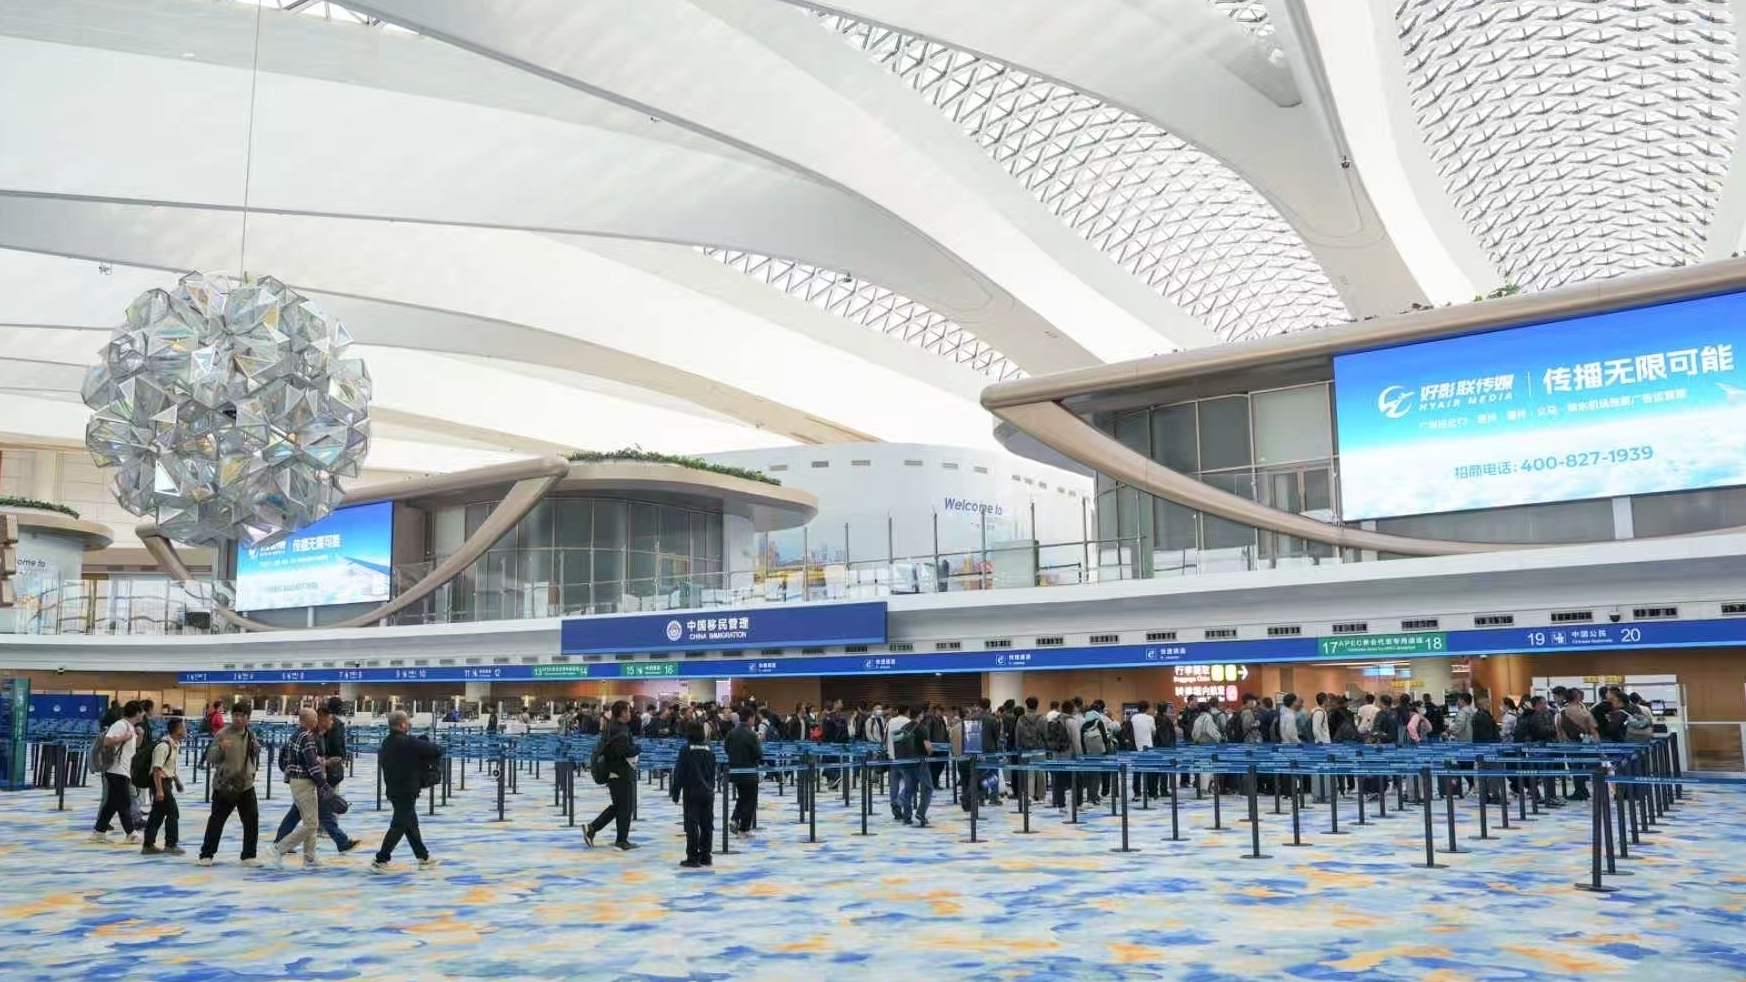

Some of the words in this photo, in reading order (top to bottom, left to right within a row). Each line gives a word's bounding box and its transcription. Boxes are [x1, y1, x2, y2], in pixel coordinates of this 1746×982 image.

[1543, 344, 1734, 395] 传播无限可能
[1420, 374, 1514, 400] 好影联传媒
[1419, 398, 1460, 412] HYAIR
[1468, 391, 1513, 405] MEDIA
[1521, 445, 1654, 472] 400-827-1939
[944, 497, 993, 515] Welcome
[687, 617, 749, 632] 中国移民管理
[709, 631, 747, 640] IMMIGRATION
[1527, 632, 1545, 646] 19
[1571, 629, 1607, 638] 中国公民
[1620, 628, 1641, 642] 20
[1322, 641, 1338, 655] 17
[1425, 637, 1443, 650] 18
[627, 665, 635, 675] 15
[664, 664, 674, 675] 16
[1174, 665, 1211, 676] 行李提取
